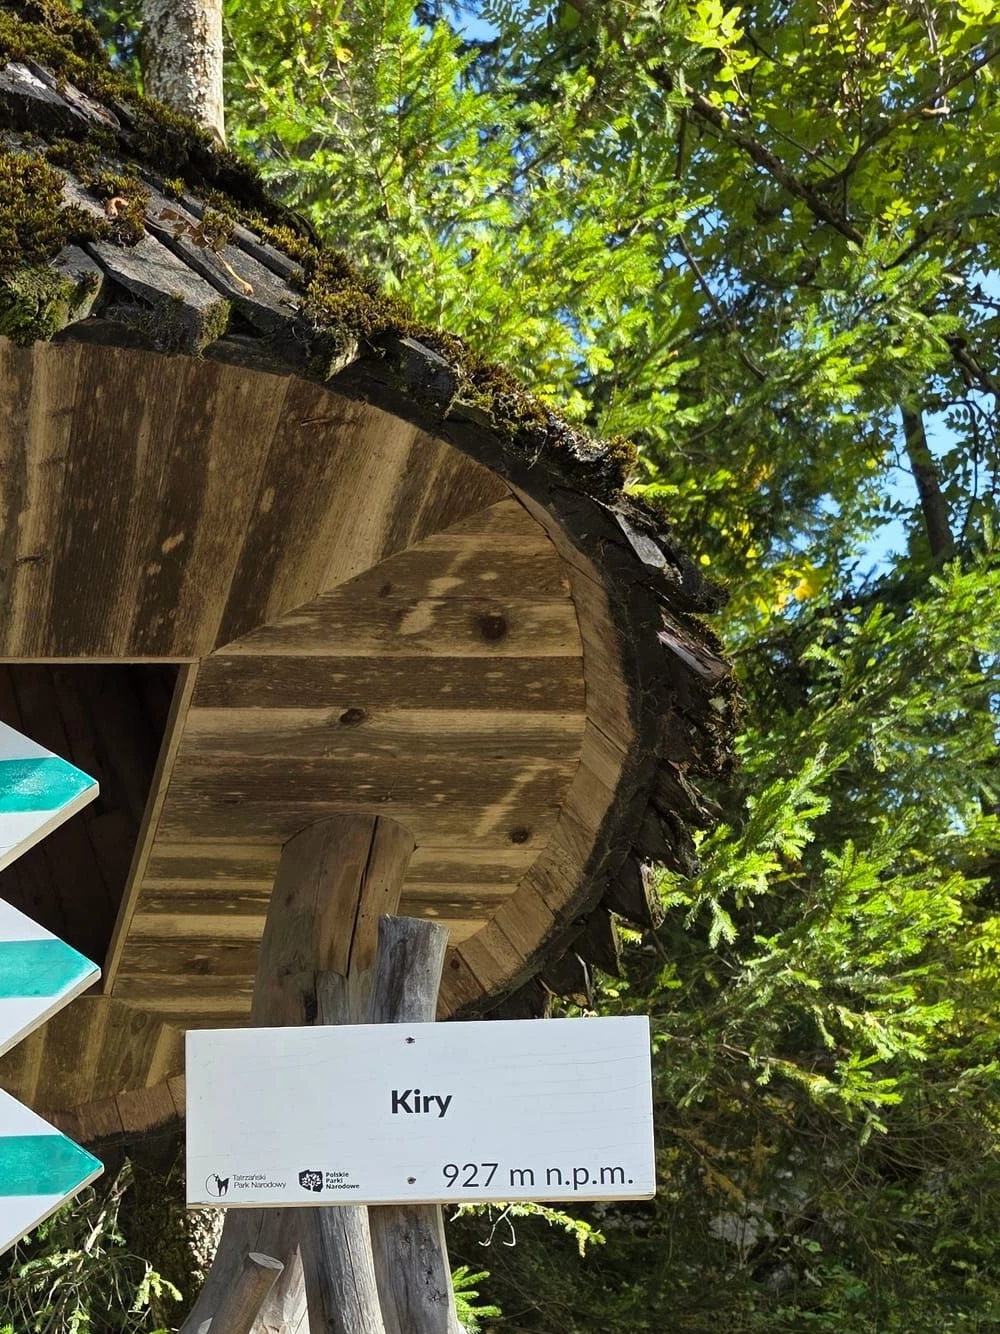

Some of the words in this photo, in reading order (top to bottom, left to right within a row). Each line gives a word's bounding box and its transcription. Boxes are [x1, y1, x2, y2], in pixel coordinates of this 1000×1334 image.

[391, 1088, 453, 1119] Kiry
[442, 1162, 499, 1188] 927
[509, 1168, 535, 1187] m
[546, 1166, 634, 1191] n.p.m.
